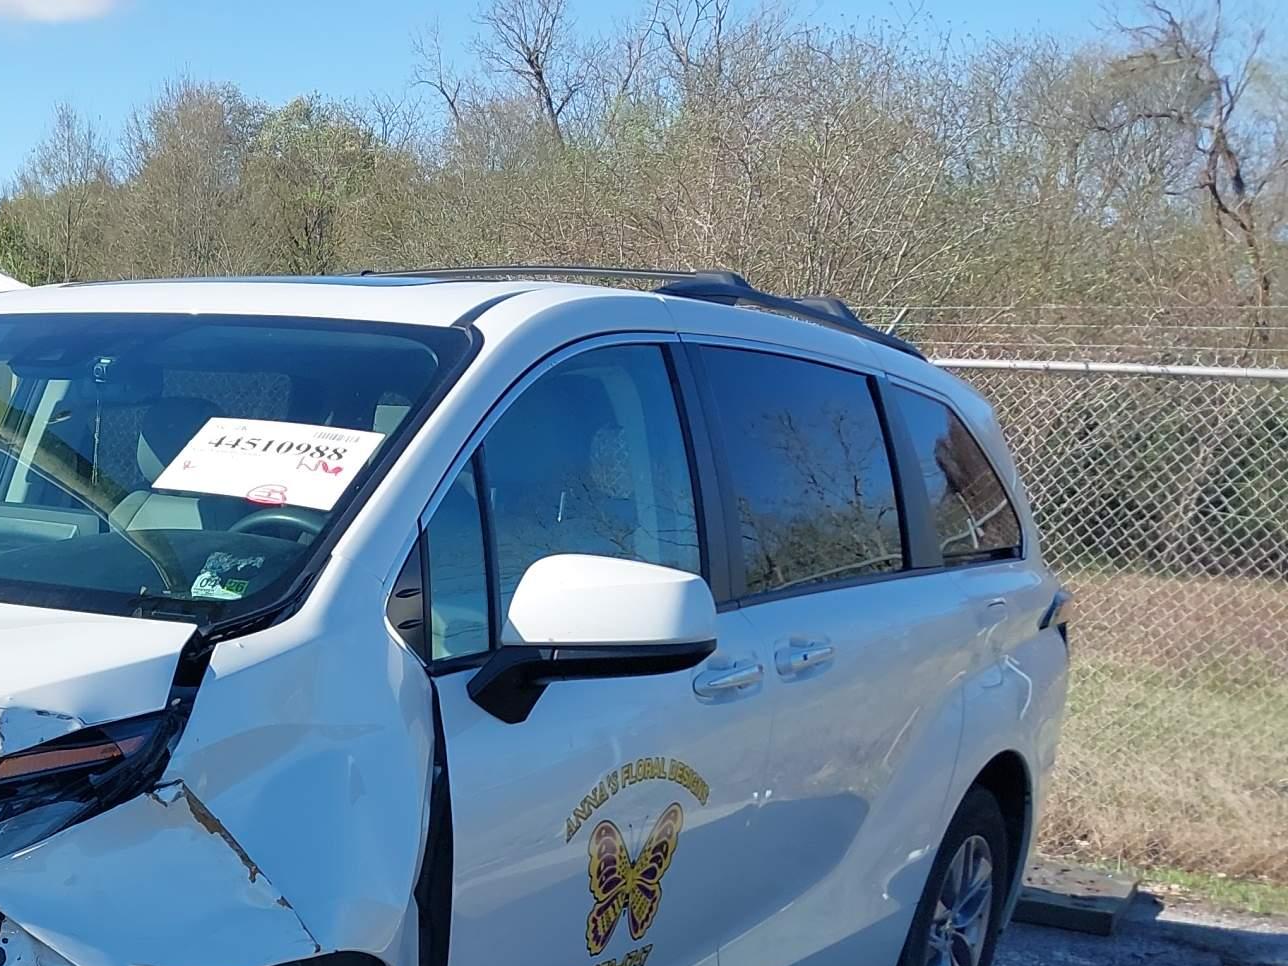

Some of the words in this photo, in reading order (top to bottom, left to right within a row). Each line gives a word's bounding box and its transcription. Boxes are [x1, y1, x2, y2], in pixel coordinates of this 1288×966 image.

[208, 434, 348, 462] 44510988
[621, 757, 666, 788] FLORAL
[668, 758, 710, 806] DESIGNS
